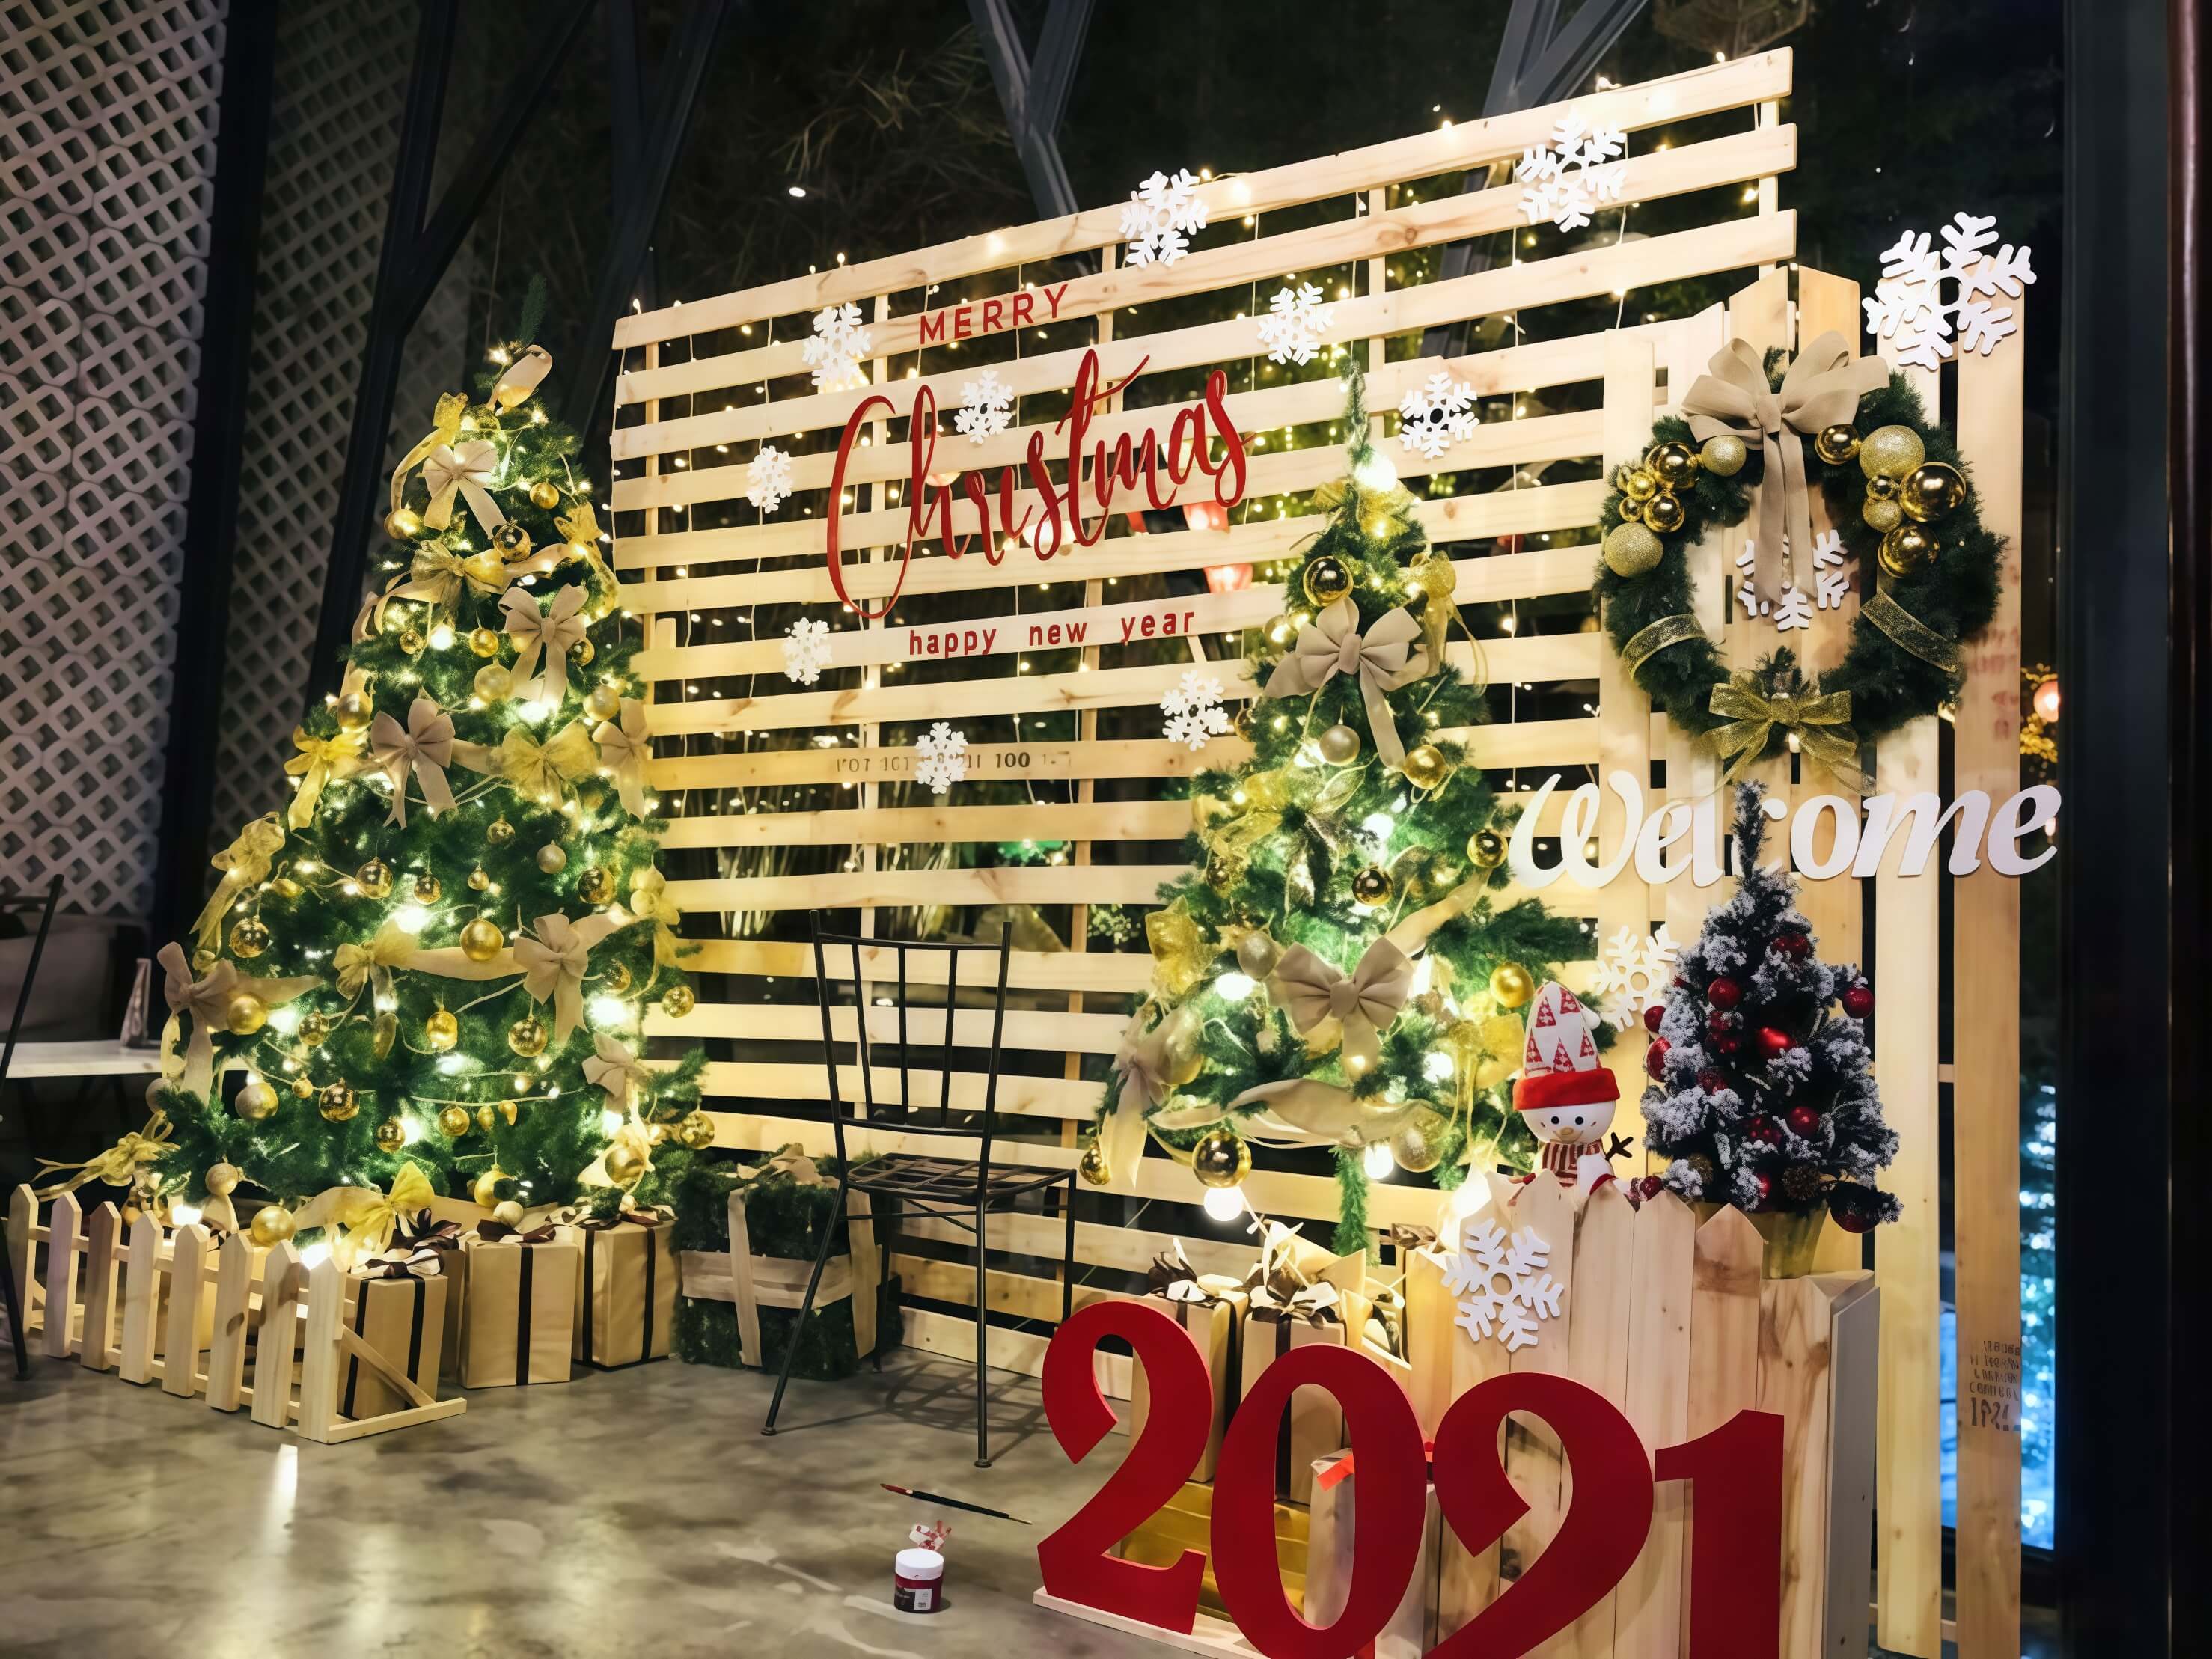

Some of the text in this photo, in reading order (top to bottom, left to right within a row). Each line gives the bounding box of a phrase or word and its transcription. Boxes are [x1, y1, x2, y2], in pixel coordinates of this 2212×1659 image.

[920, 283, 1069, 345] MERRY
[826, 349, 1255, 619] Christmas
[909, 611, 1195, 657] happy new year
[1037, 1299, 1785, 1659] 2021
